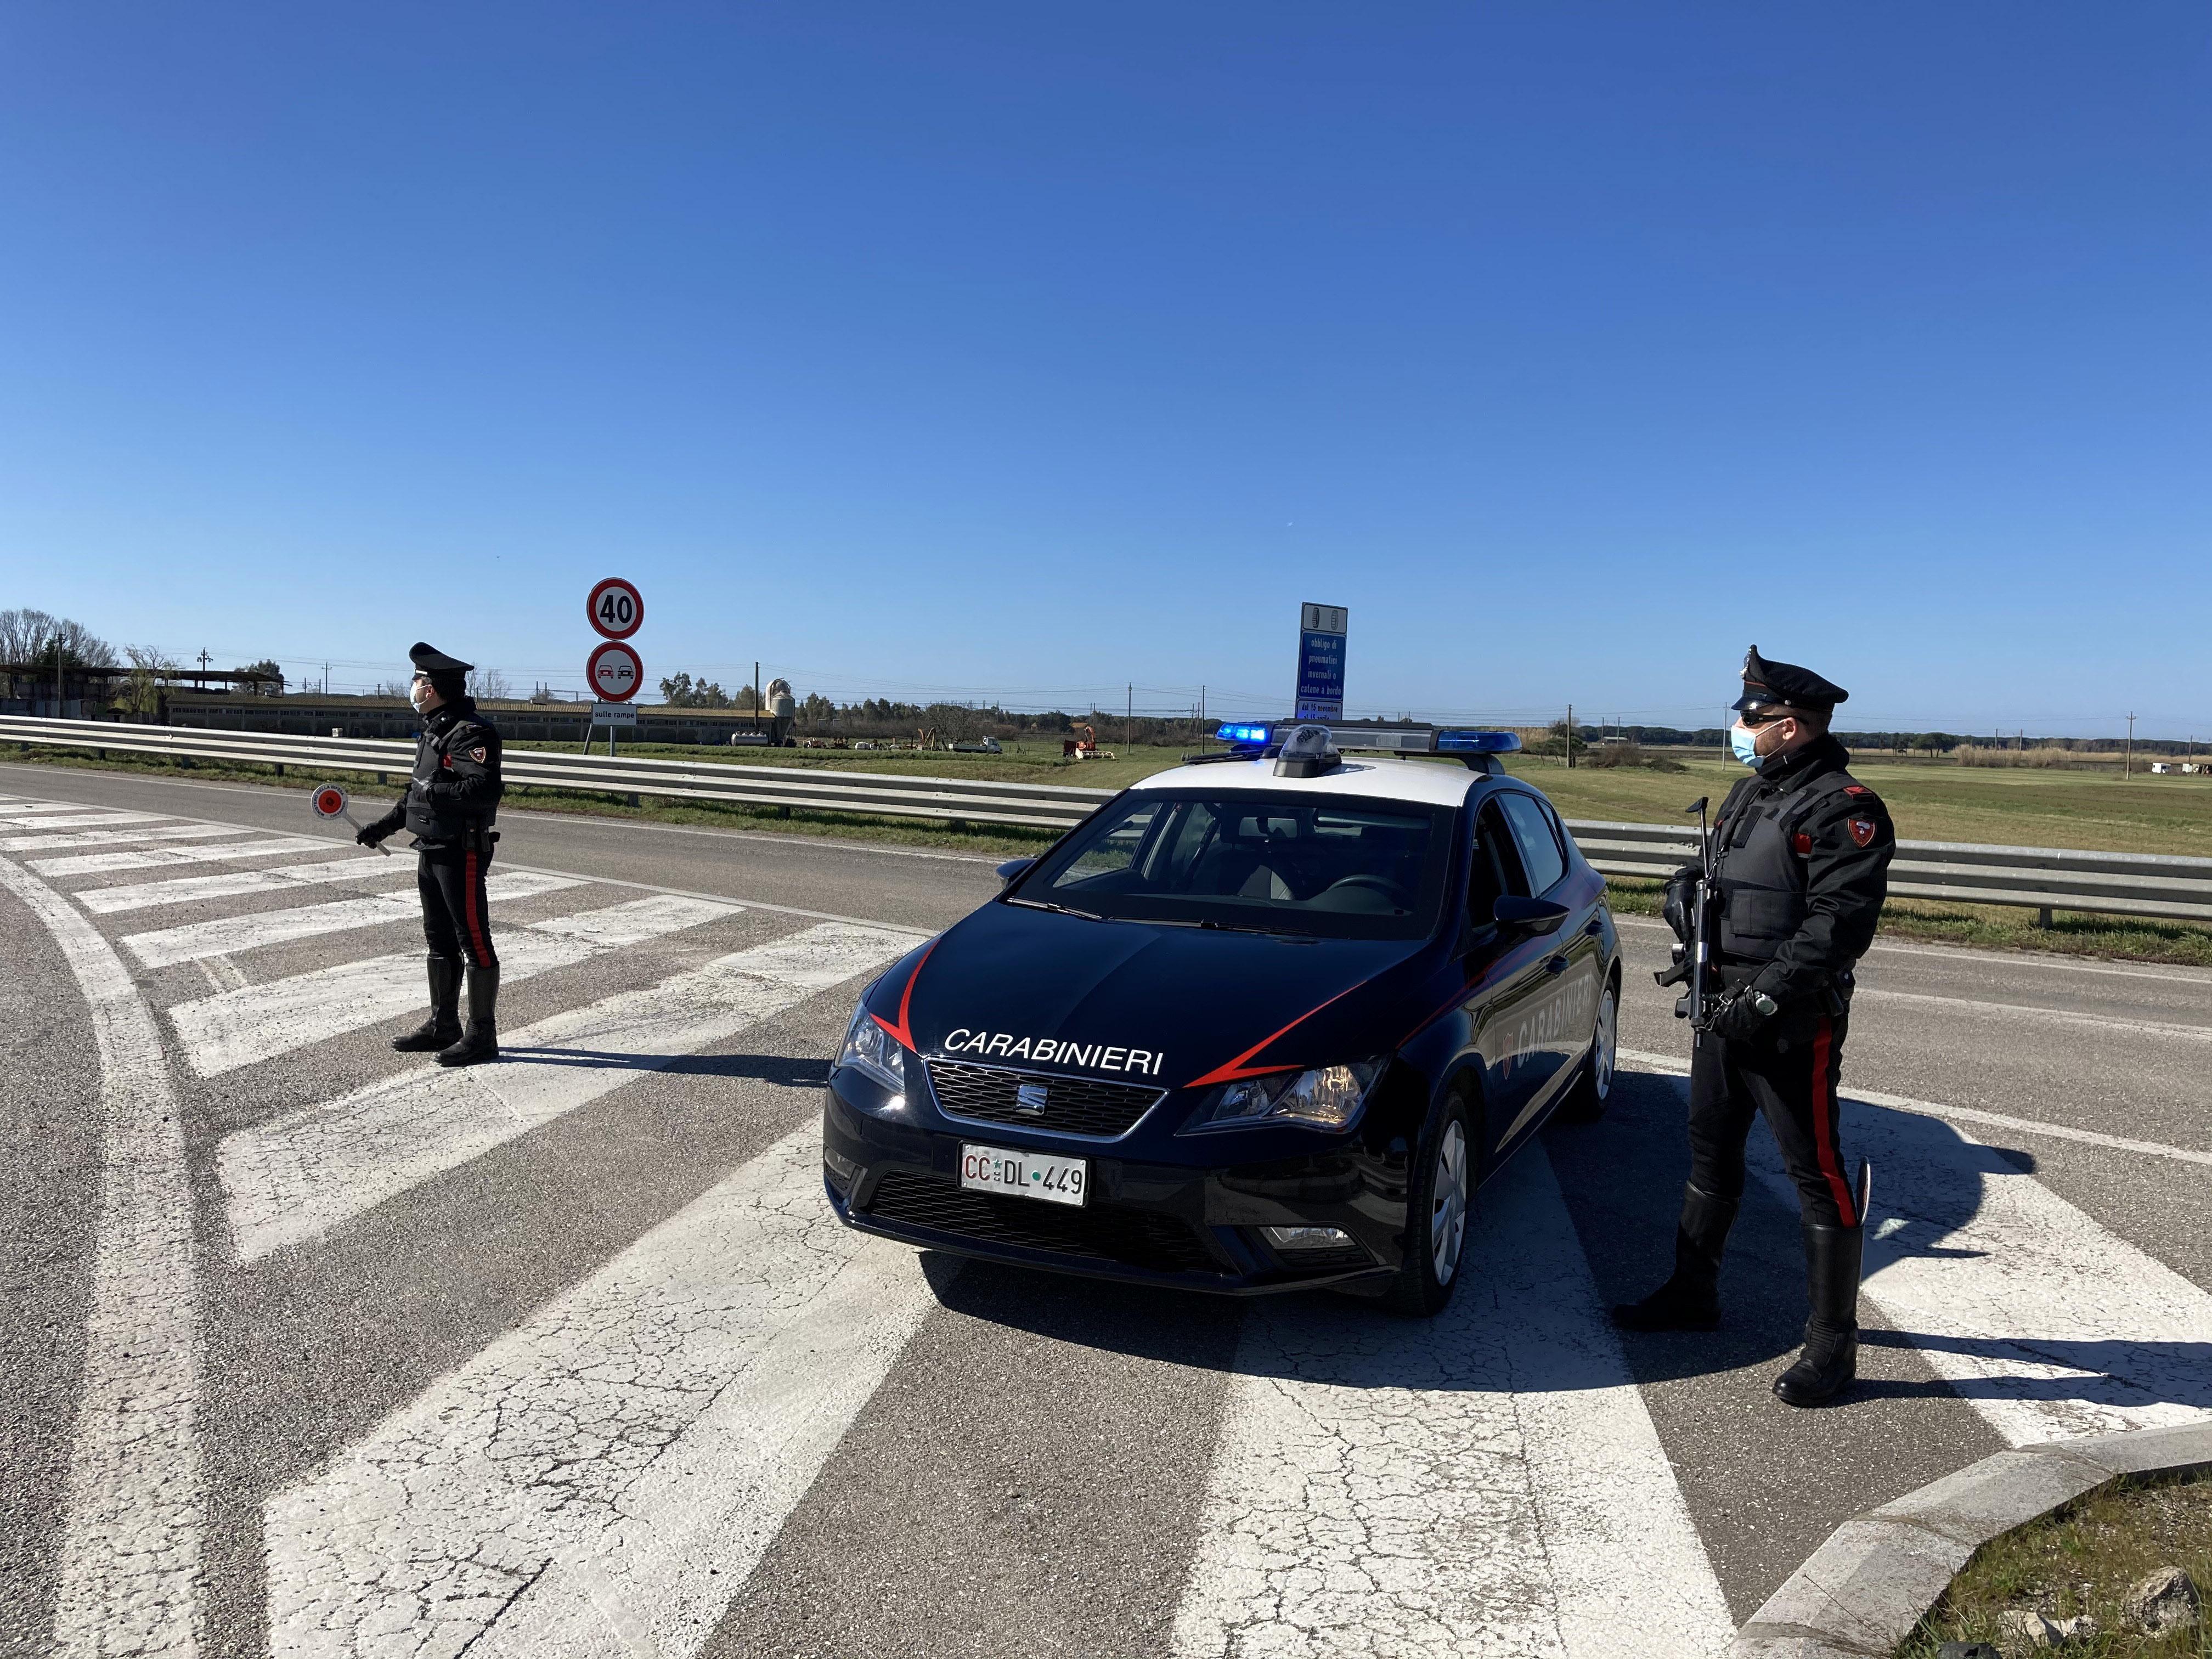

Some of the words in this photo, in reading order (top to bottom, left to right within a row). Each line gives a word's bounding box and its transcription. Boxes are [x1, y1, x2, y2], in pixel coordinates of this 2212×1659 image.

[600, 595, 633, 624] 40
[1311, 637, 1330, 650] obbligo
[1332, 639, 1337, 650] di
[1308, 655, 1338, 664] pneumatici
[1307, 668, 1331, 679] invernali
[1300, 684, 1319, 694] catene
[1327, 685, 1342, 695] bordo
[1311, 703, 1316, 712] 15
[317, 785, 330, 795] DELLA
[944, 1029, 1164, 1075] CARABINIERI
[965, 1154, 990, 1181] CC
[1003, 1159, 1029, 1187] DL
[1041, 1165, 1082, 1194] 449
